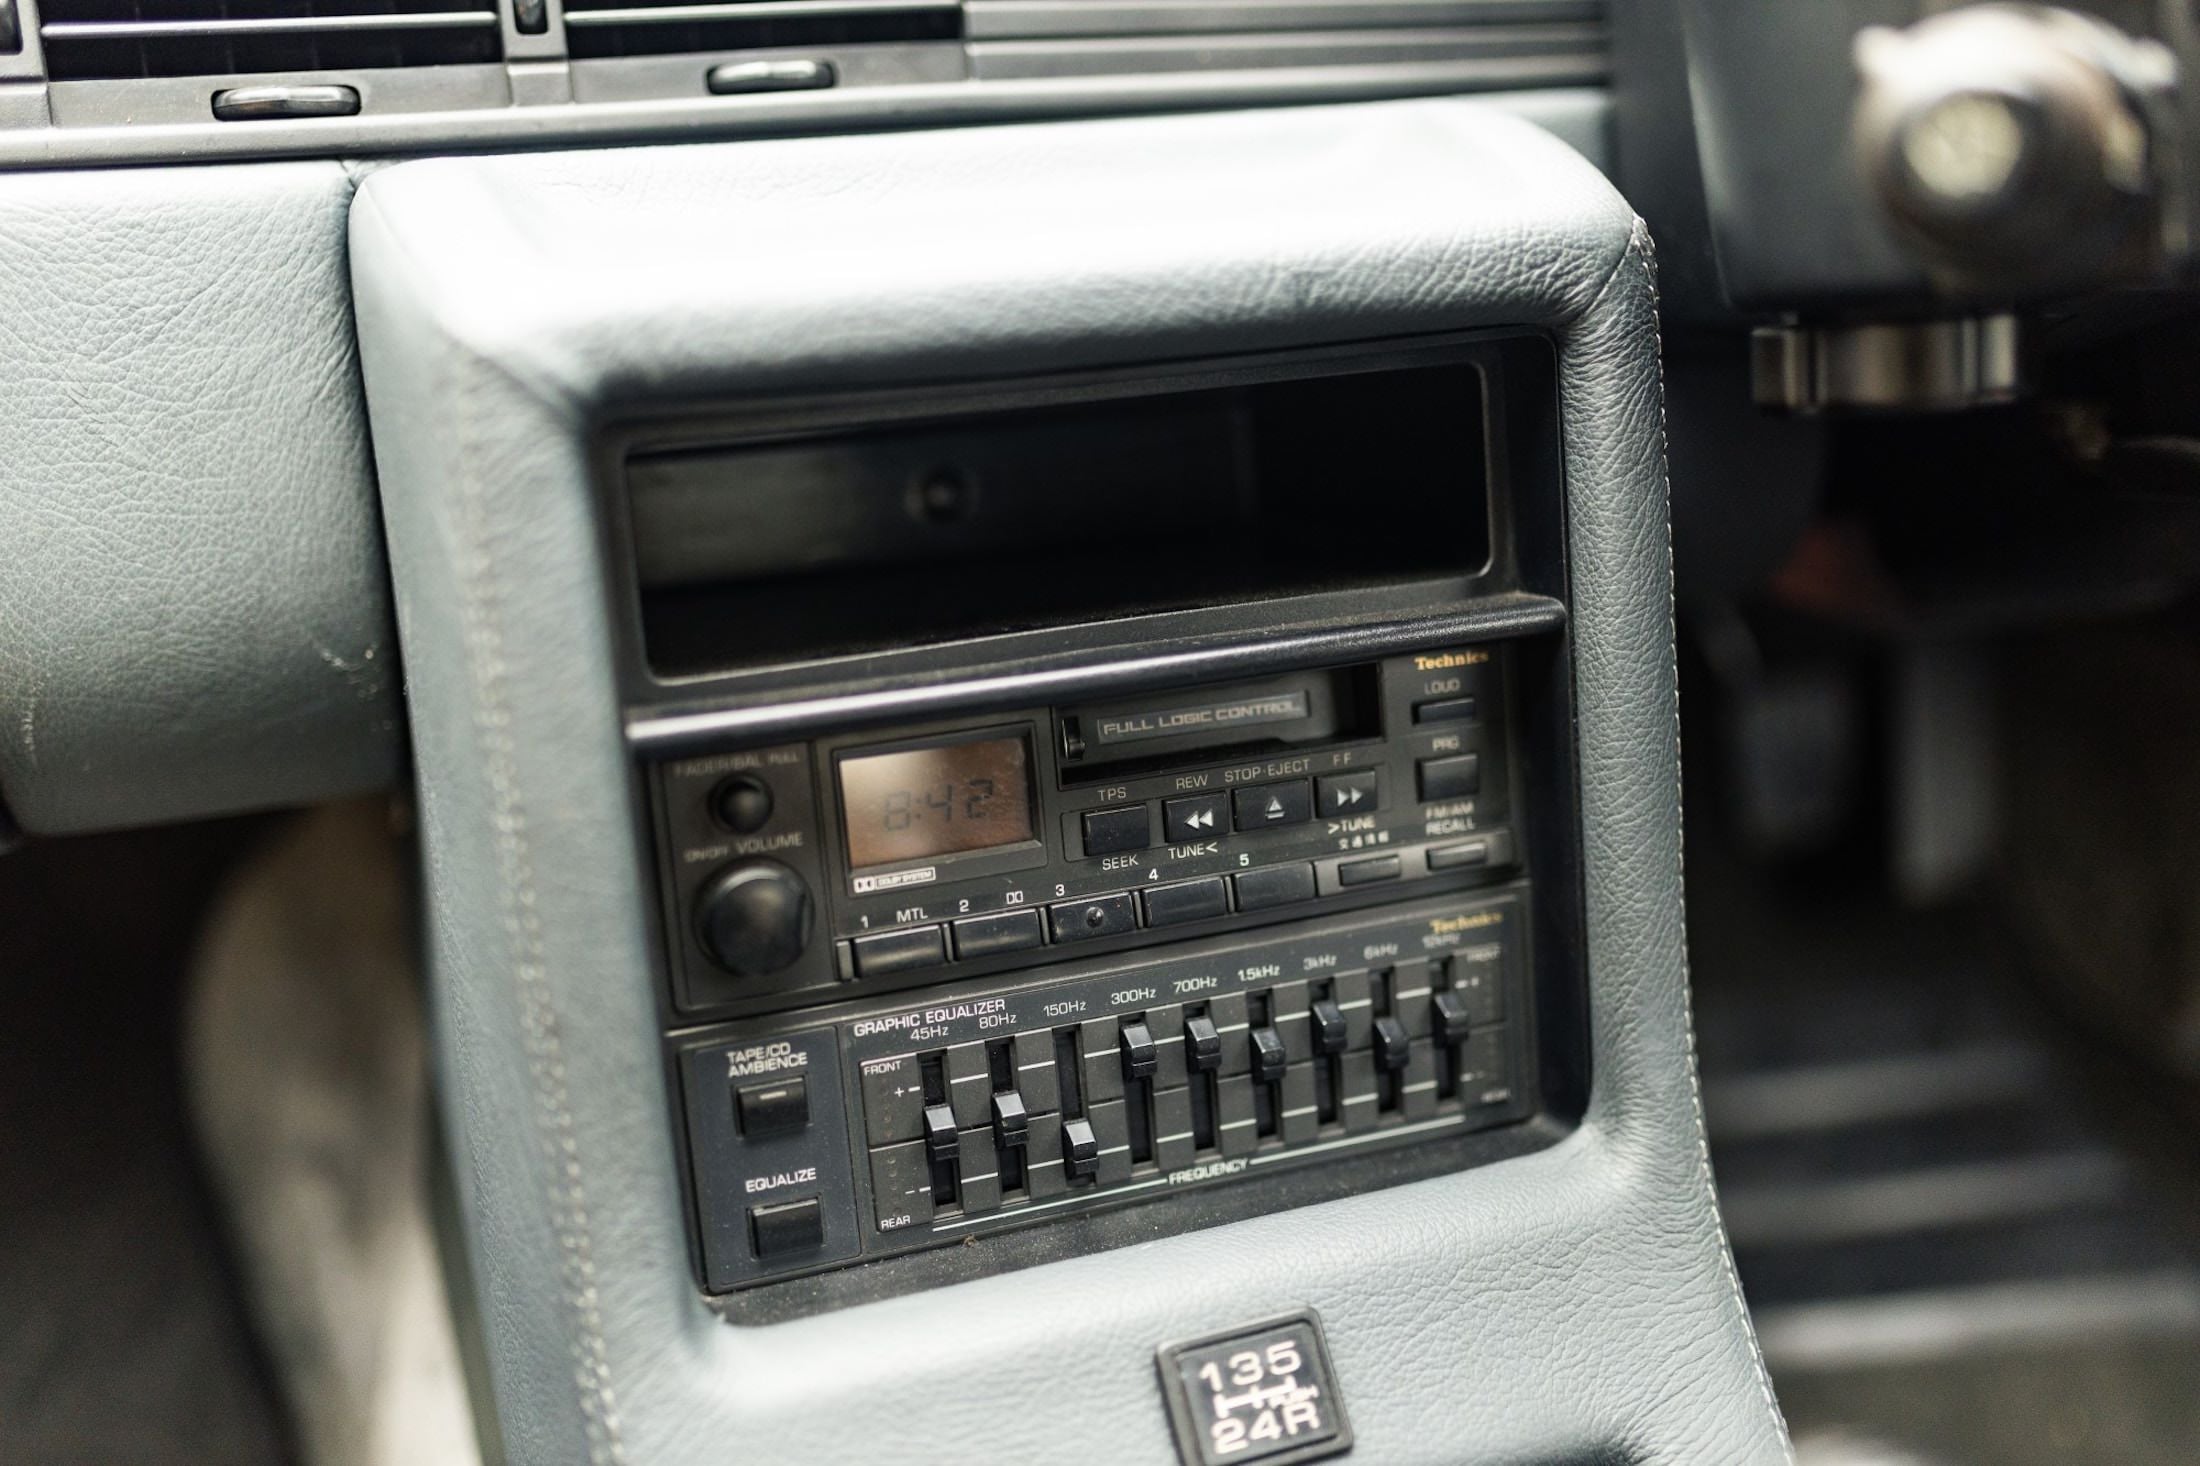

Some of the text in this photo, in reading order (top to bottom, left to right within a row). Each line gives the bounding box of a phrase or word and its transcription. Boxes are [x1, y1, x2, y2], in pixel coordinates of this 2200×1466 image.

[1414, 651, 1489, 671] Technics
[1424, 678, 1461, 695] LOUD
[1103, 702, 1299, 736] FULL LOGIC CONTROL
[1176, 775, 1208, 790] REW
[1098, 786, 1127, 801] TPS
[884, 779, 993, 832] 8:42
[735, 832, 803, 855] VOLUME
[1102, 854, 1139, 871] SEEK
[1239, 853, 1249, 867] 5
[1149, 868, 1159, 881] 4
[1055, 884, 1065, 897] 3
[959, 899, 969, 913] 2
[860, 915, 869, 929] 1
[896, 907, 928, 923] MTL
[910, 1025, 949, 1041] 45Hz
[979, 1013, 1017, 1029] 80Hz
[1043, 1000, 1087, 1018] 150Hz
[1111, 987, 1157, 1005] 300Hz
[1173, 976, 1218, 994] 700Hz
[854, 999, 1006, 1037] GRAPHIC EQUALIZER
[727, 1042, 791, 1065] TAPE/CD
[728, 1052, 808, 1078] AMBIENCE
[863, 1060, 902, 1076] FRONT
[1168, 1158, 1248, 1185] FREQUENCY
[745, 1168, 817, 1193] EQUALIZE
[880, 1215, 911, 1231] REAR
